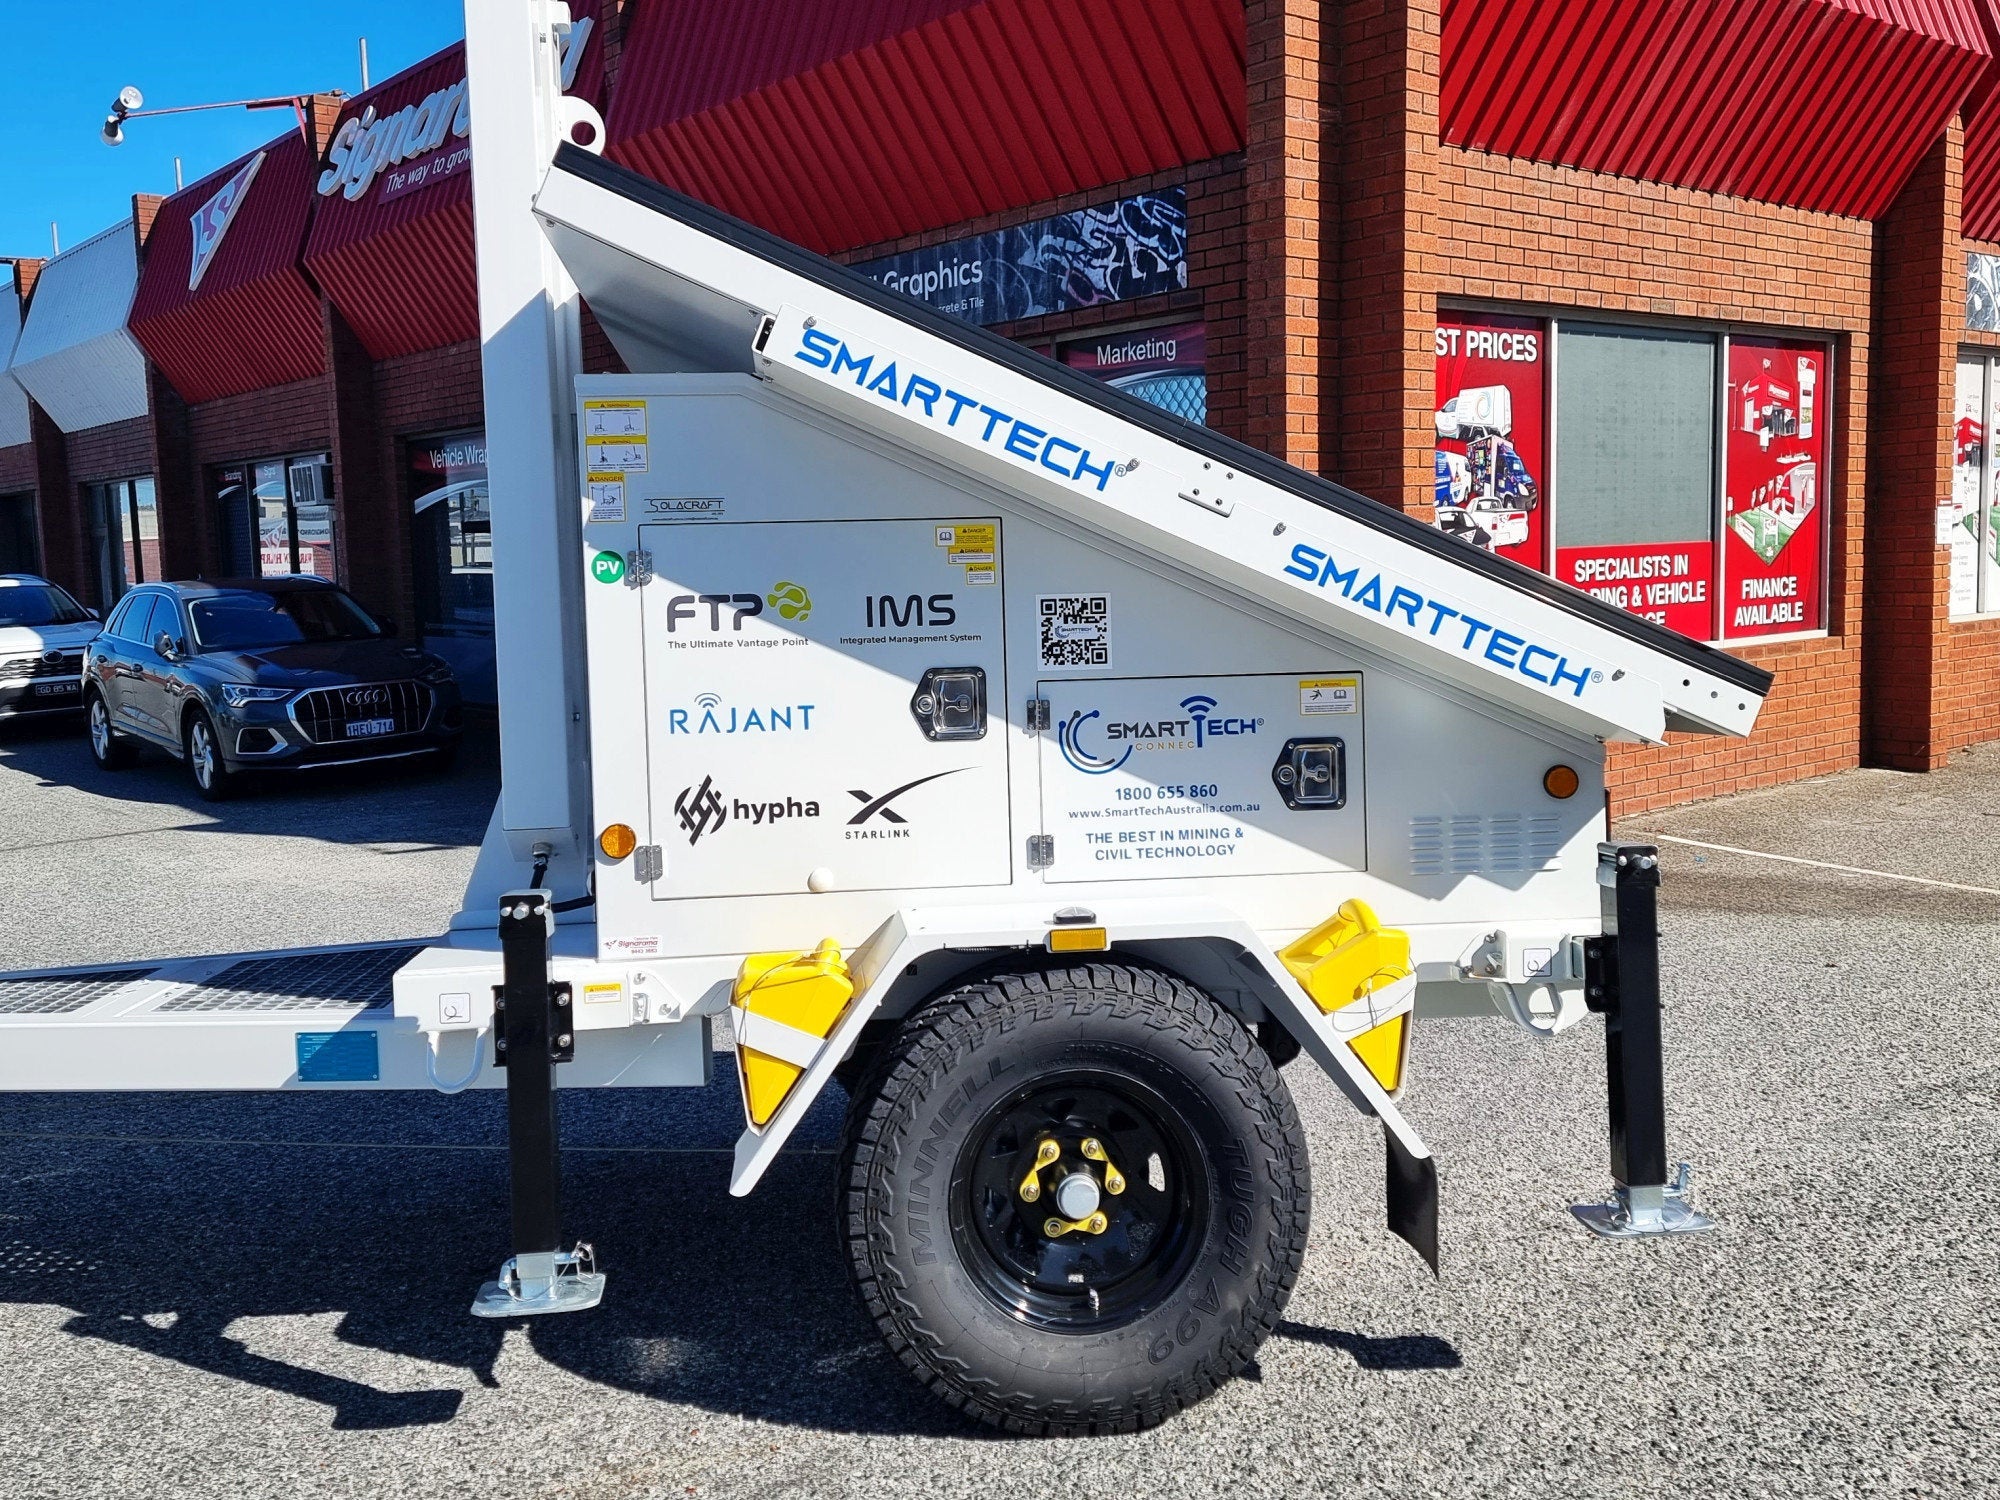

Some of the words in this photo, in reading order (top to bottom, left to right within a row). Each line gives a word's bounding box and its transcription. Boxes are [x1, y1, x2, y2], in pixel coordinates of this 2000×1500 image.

[386, 172, 405, 193] The
[407, 164, 431, 185] way
[432, 157, 446, 175] to
[882, 257, 984, 301] Graphics
[969, 297, 985, 309] Tile
[1097, 338, 1177, 367] Marketing
[1466, 330, 1538, 362] PRICES
[429, 448, 464, 469] Vehicle
[650, 498, 723, 513] SOLACRAFT
[596, 560, 620, 575] PV
[1574, 556, 1671, 583] SPECIALISTS
[1674, 554, 1689, 576] IN
[1631, 585, 1643, 607] &
[1646, 580, 1706, 606] VEHICLE
[1742, 576, 1797, 600] FINANCE
[667, 594, 763, 633] FTP
[866, 594, 956, 628] IMS
[1734, 602, 1804, 627] AVAILABLE
[668, 640, 687, 650] The
[689, 639, 734, 649] Ultimate
[736, 639, 779, 650] Vantage
[782, 637, 809, 647] Point
[840, 636, 886, 647] Integrated
[888, 635, 947, 645] Management
[949, 633, 982, 644] System
[669, 704, 815, 734] RAJANT
[1115, 787, 1152, 801] 1800
[1157, 786, 1185, 799] 655
[1189, 784, 1218, 798] 860
[733, 796, 820, 825] hypha
[1068, 801, 1261, 819] www.SmartTechAustralia.com.au
[845, 829, 911, 840] STARLINK
[1086, 833, 1113, 844] THE
[1118, 831, 1156, 843] BEST
[1160, 830, 1175, 842] IN
[1178, 828, 1230, 841] MINING
[1235, 827, 1244, 838] &
[1095, 849, 1132, 861] CIVIL
[1136, 845, 1236, 860] TECHNOLOGY
[618, 940, 659, 949] Signarama
[908, 1058, 1016, 1267] MINNELL
